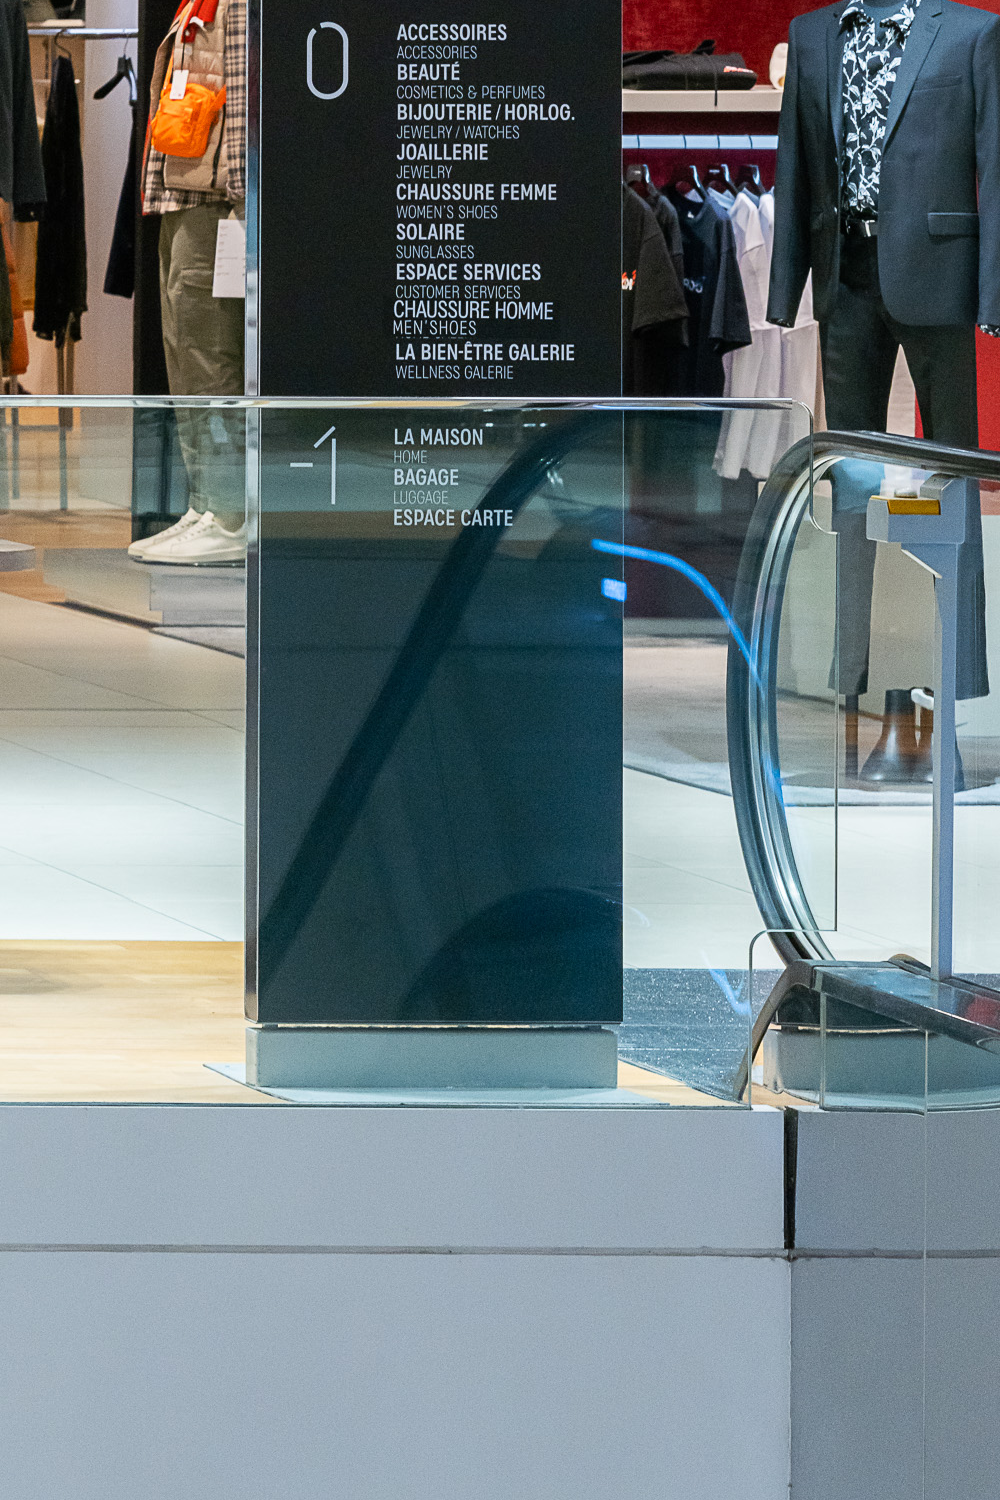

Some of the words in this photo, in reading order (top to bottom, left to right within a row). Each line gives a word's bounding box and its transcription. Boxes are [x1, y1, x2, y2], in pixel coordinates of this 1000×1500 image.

[397, 24, 507, 41] ACCESSOIRES
[397, 45, 478, 59] ACCESSORIES
[397, 61, 460, 80] BEAUTÉ
[396, 85, 464, 99] COSMETICS
[467, 85, 478, 99] &
[481, 85, 546, 99] PERFUMES
[397, 104, 492, 121] BIJOUTERIE
[504, 104, 576, 121] HORLOG.
[396, 125, 453, 139] JEWELRY
[463, 125, 520, 139] WATCHES
[396, 143, 489, 160] JOAILLERIE
[396, 165, 453, 179] JEWELRY
[396, 183, 495, 200] CHAUSSURE
[500, 183, 557, 200] FEMME
[396, 205, 455, 219] WOMEN'S
[458, 205, 498, 219] SHOES
[396, 223, 465, 240] SOLAIRE
[396, 245, 475, 259] SUNGLASSES
[396, 263, 458, 280] ESPACE
[463, 263, 541, 281] SERVICES
[395, 285, 460, 299] CUSTOMER
[464, 285, 521, 299] SERVICES
[393, 300, 490, 319] CHAUSSURE
[495, 301, 554, 320] HOMME
[395, 343, 416, 361] LA
[421, 341, 504, 361] BIEN-ÊTRE
[508, 344, 575, 361] GALERIE
[395, 365, 461, 379] WELLNESS
[464, 365, 514, 380] GALERIE
[394, 428, 415, 445] LA
[420, 428, 484, 446] MAISON
[290, 426, 336, 505] -1
[393, 450, 427, 464] HOME
[393, 468, 459, 486] BAGAGE
[393, 490, 449, 505] LUGGAGE
[393, 509, 455, 526] ESPACE
[461, 509, 514, 527] CARTE
